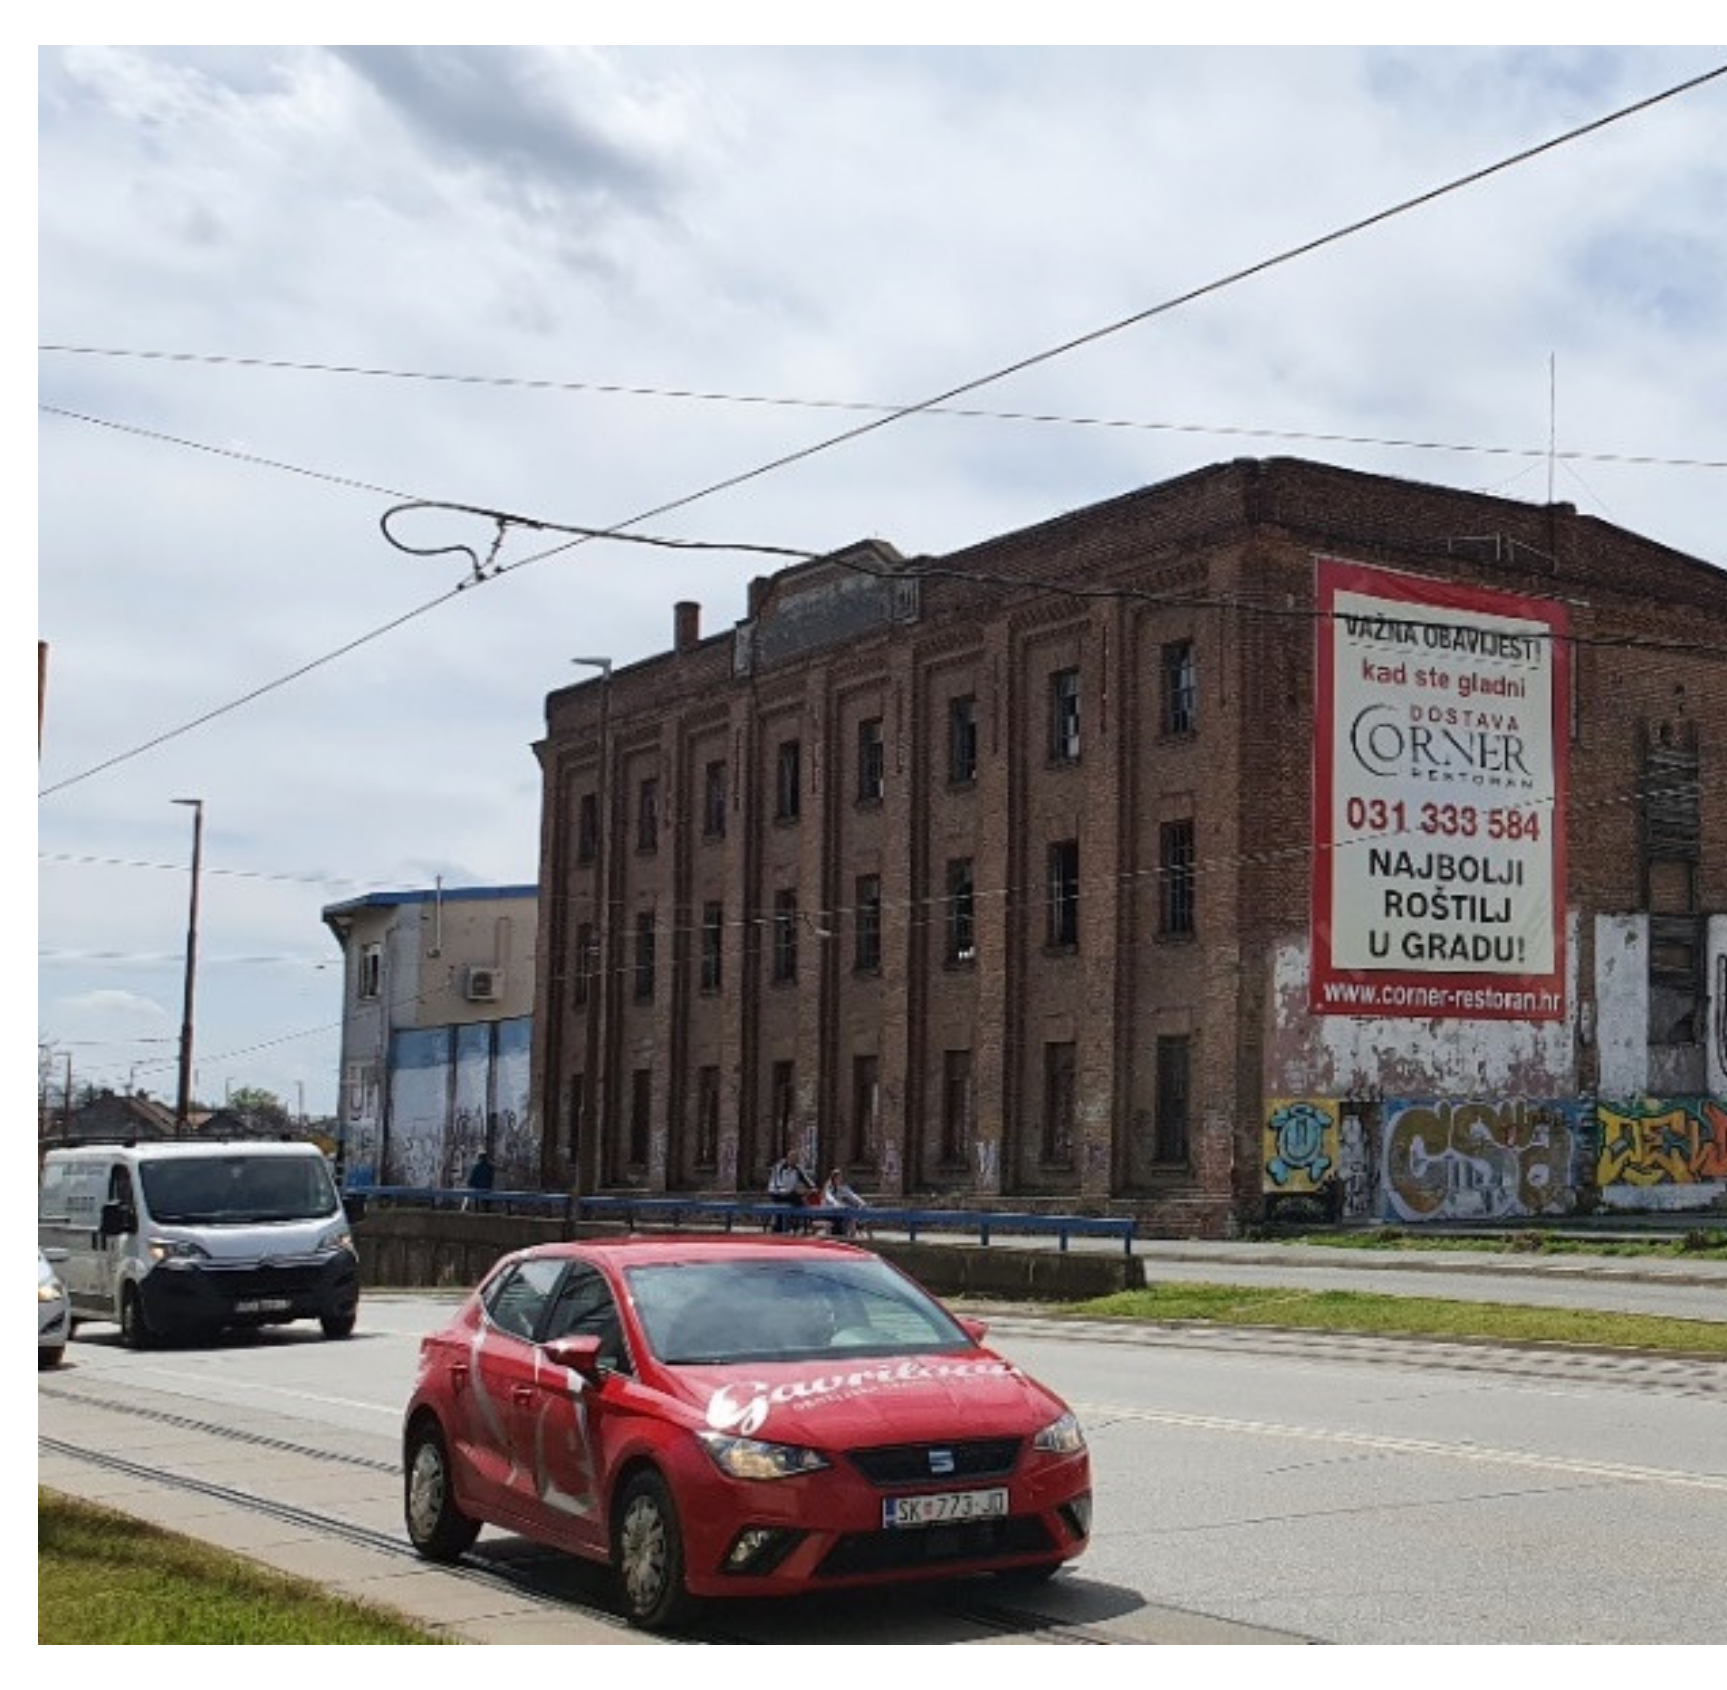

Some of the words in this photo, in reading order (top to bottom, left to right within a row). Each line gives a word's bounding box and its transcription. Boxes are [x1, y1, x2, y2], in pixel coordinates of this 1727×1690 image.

[1362, 658, 1406, 685] kad
[1415, 667, 1449, 690] ste
[1458, 673, 1525, 698] gladni
[1410, 705, 1519, 732] DOSTAVA
[1350, 703, 1533, 776] CORNER
[1347, 798, 1406, 836] 031
[1420, 803, 1477, 837] 333
[1488, 809, 1540, 842] 584
[1369, 849, 1523, 886] NAJBOLJI
[1385, 886, 1512, 923] ROŠTILJ
[1369, 931, 1390, 958] U
[1402, 932, 1525, 963] GRADU!
[1323, 982, 1561, 1012] www.corner-restoran.hr
